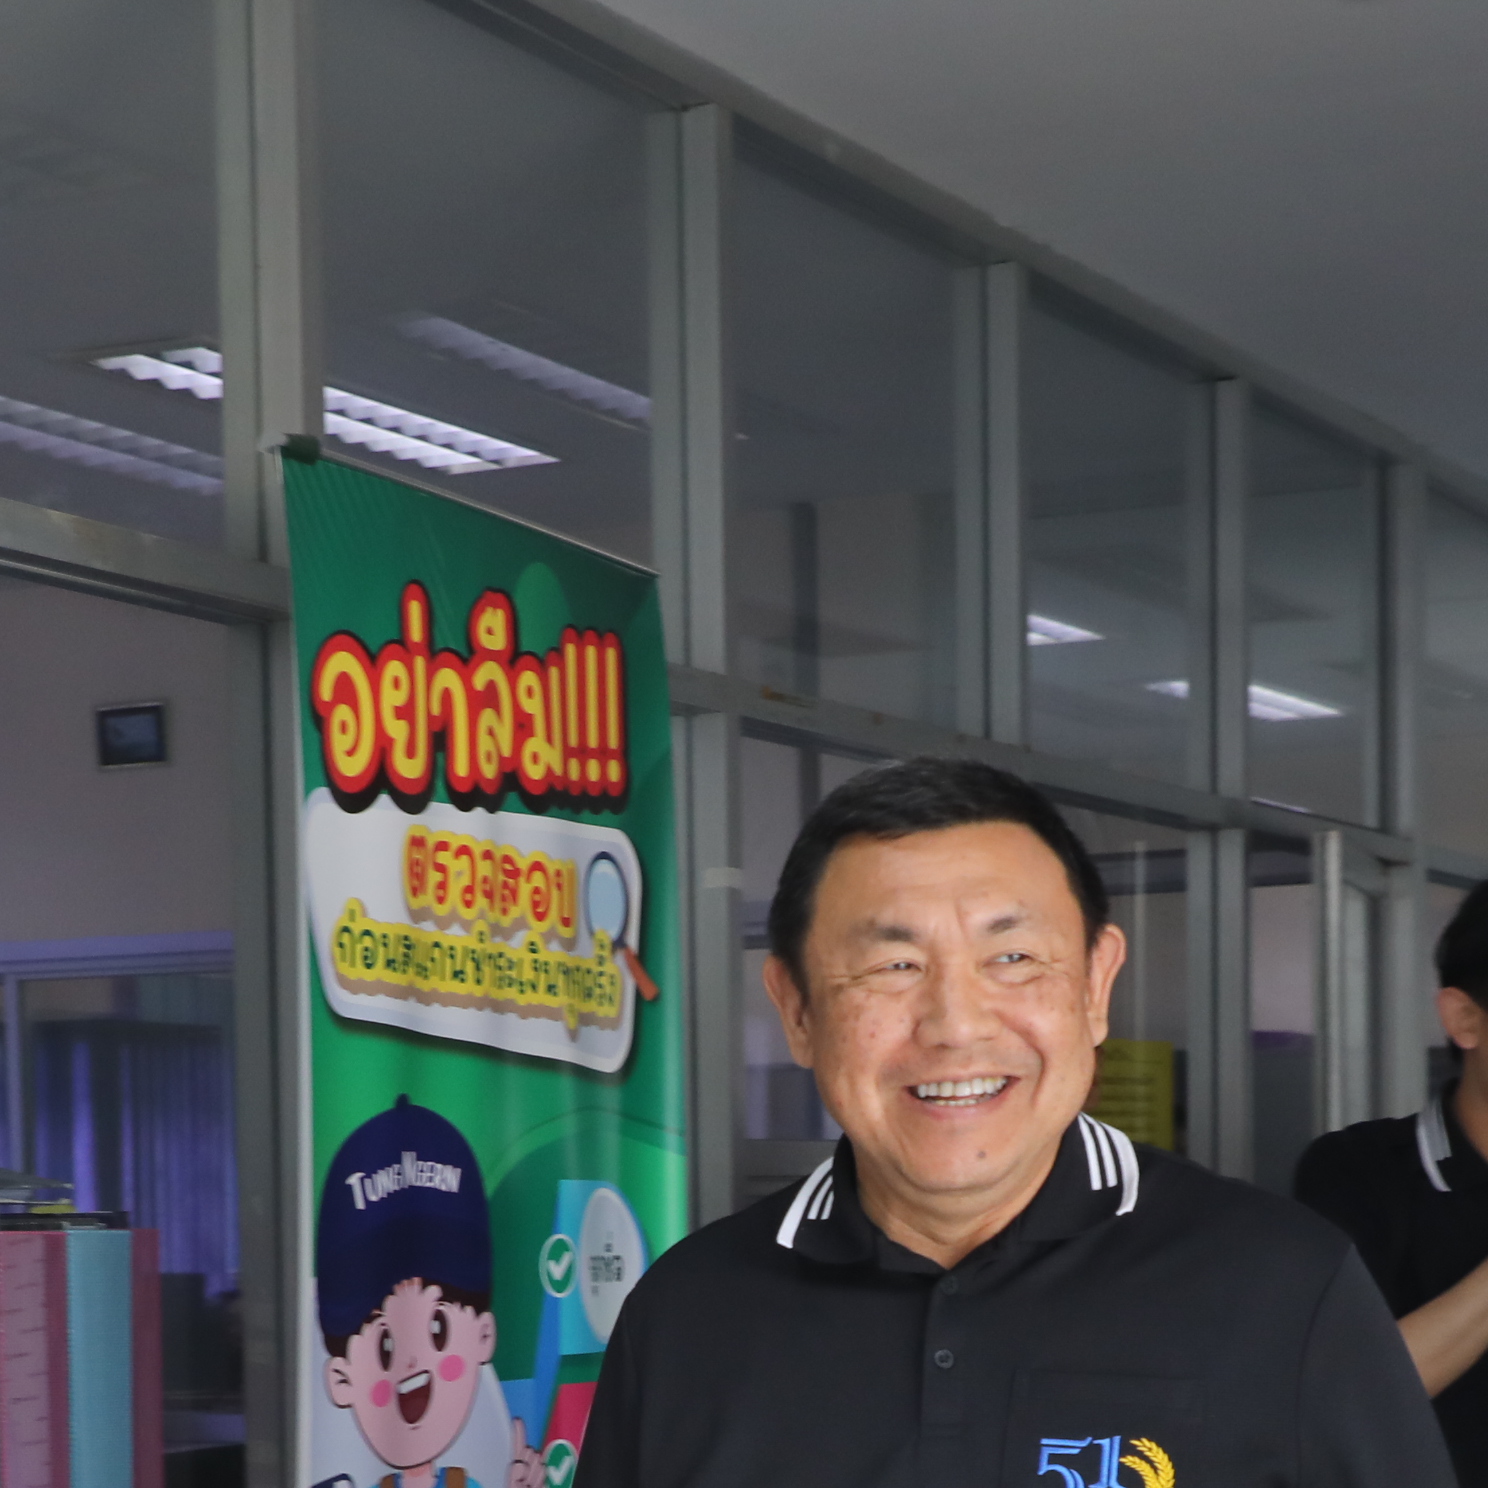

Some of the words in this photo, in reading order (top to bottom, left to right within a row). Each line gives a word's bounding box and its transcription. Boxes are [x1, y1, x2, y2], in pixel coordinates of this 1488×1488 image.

[313, 587, 625, 795] อย่าลืม!!!
[408, 830, 577, 932] ตรวจสอบ
